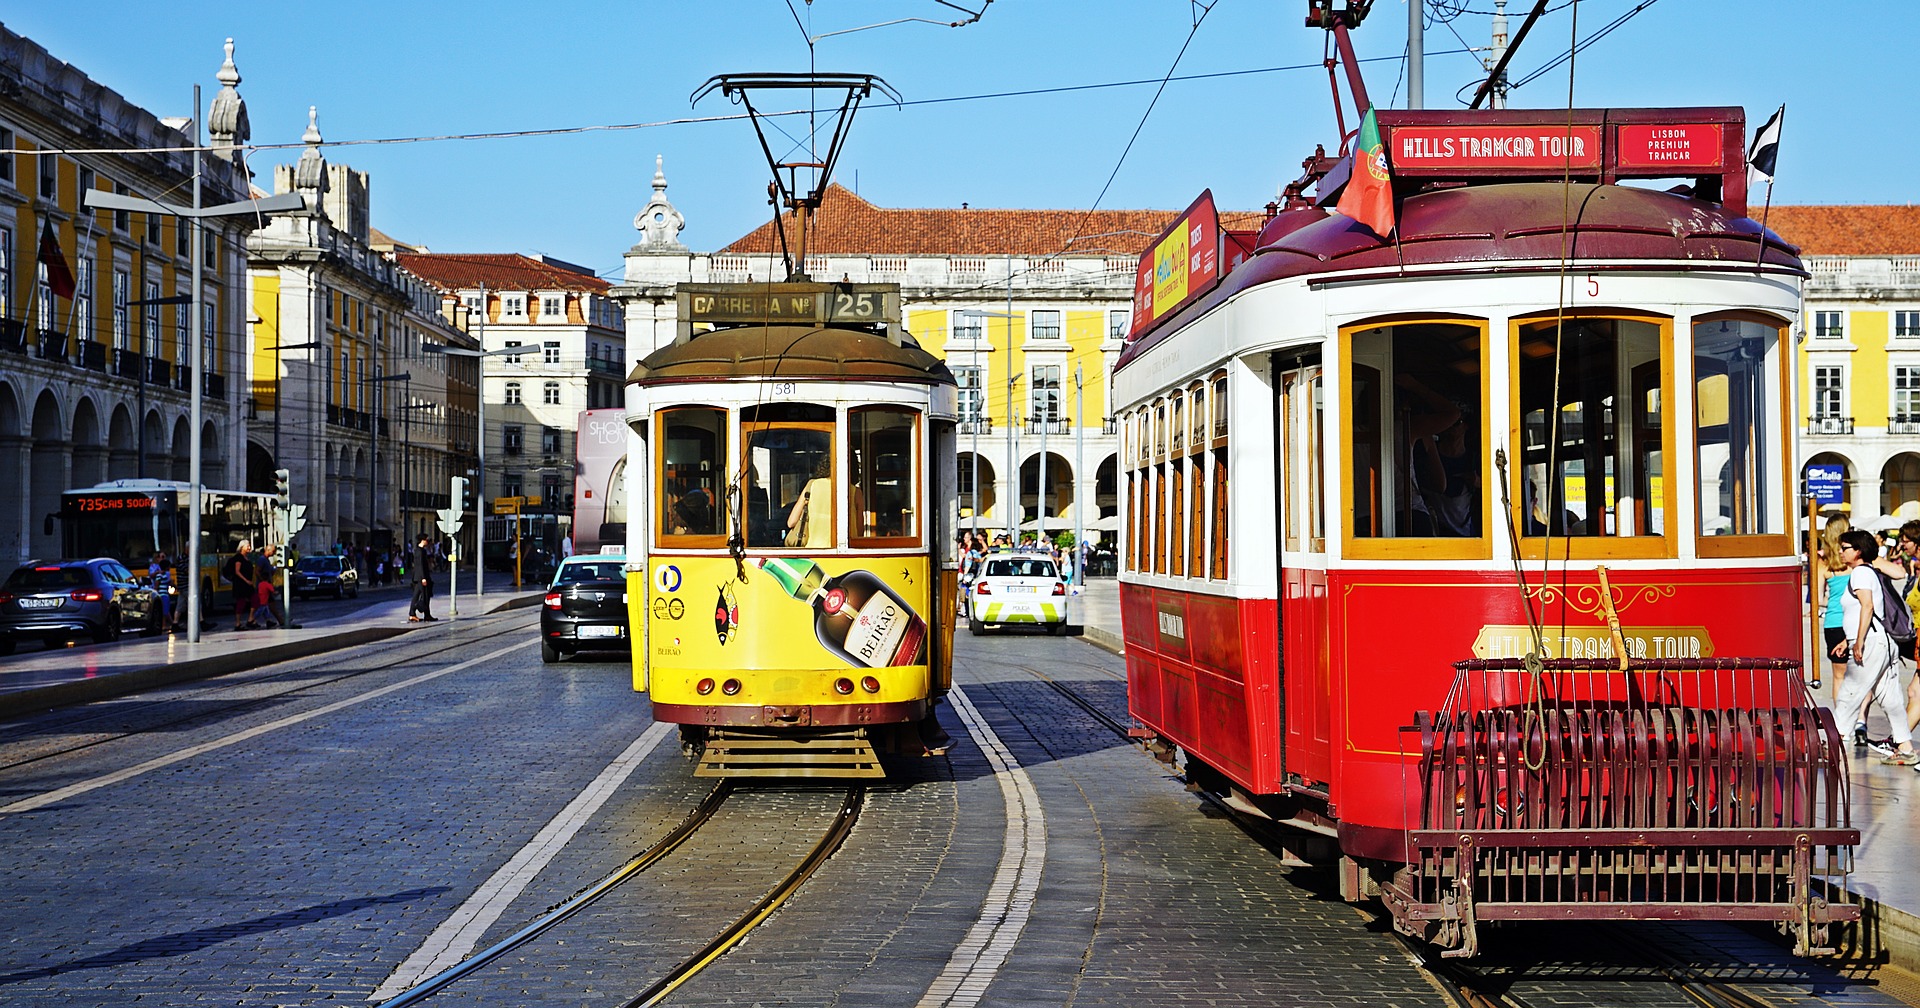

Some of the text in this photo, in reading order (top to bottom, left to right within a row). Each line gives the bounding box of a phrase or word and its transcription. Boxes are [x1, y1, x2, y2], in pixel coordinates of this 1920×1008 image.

[1651, 129, 1686, 138] LISBON
[1403, 136, 1585, 158] HILLS TRAMCAR TOUR
[1648, 140, 1690, 149] PREMIUM
[1648, 151, 1690, 160] TRAMCAR
[1587, 273, 1599, 297] 5
[837, 293, 874, 317] 25
[775, 382, 796, 396] 581
[78, 499, 102, 512] 735
[102, 499, 123, 509] CAIS
[860, 605, 896, 659] BEIRÃO
[1558, 636, 1647, 660] TRAMAR
[1652, 636, 1701, 660] TOUR
